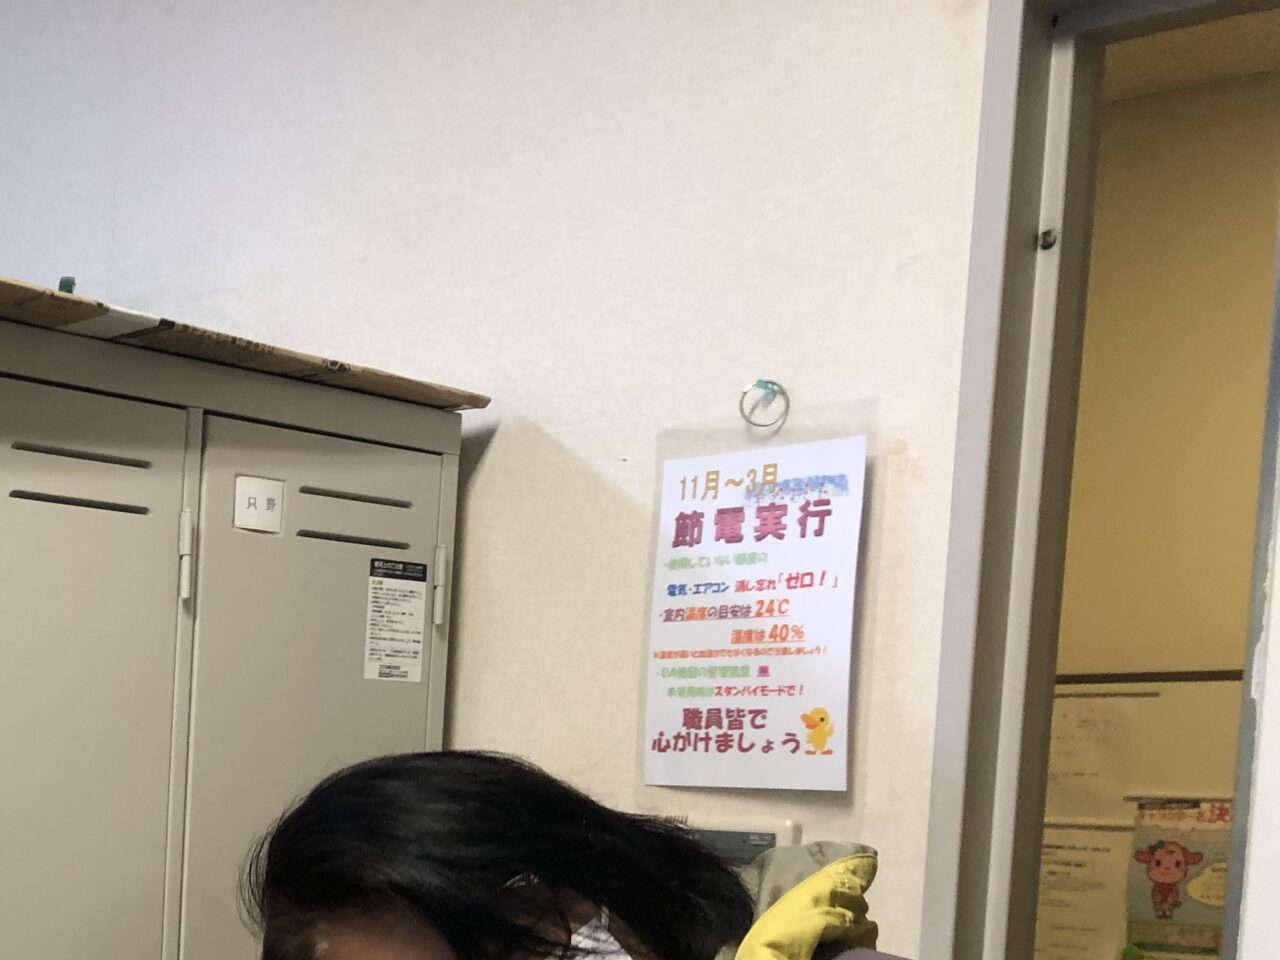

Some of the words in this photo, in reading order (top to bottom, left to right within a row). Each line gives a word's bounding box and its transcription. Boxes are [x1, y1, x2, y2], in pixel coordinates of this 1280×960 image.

[672, 499, 832, 548] 節電実行
[682, 708, 767, 731] 職員皆で
[651, 731, 801, 754] 心がけましょう
